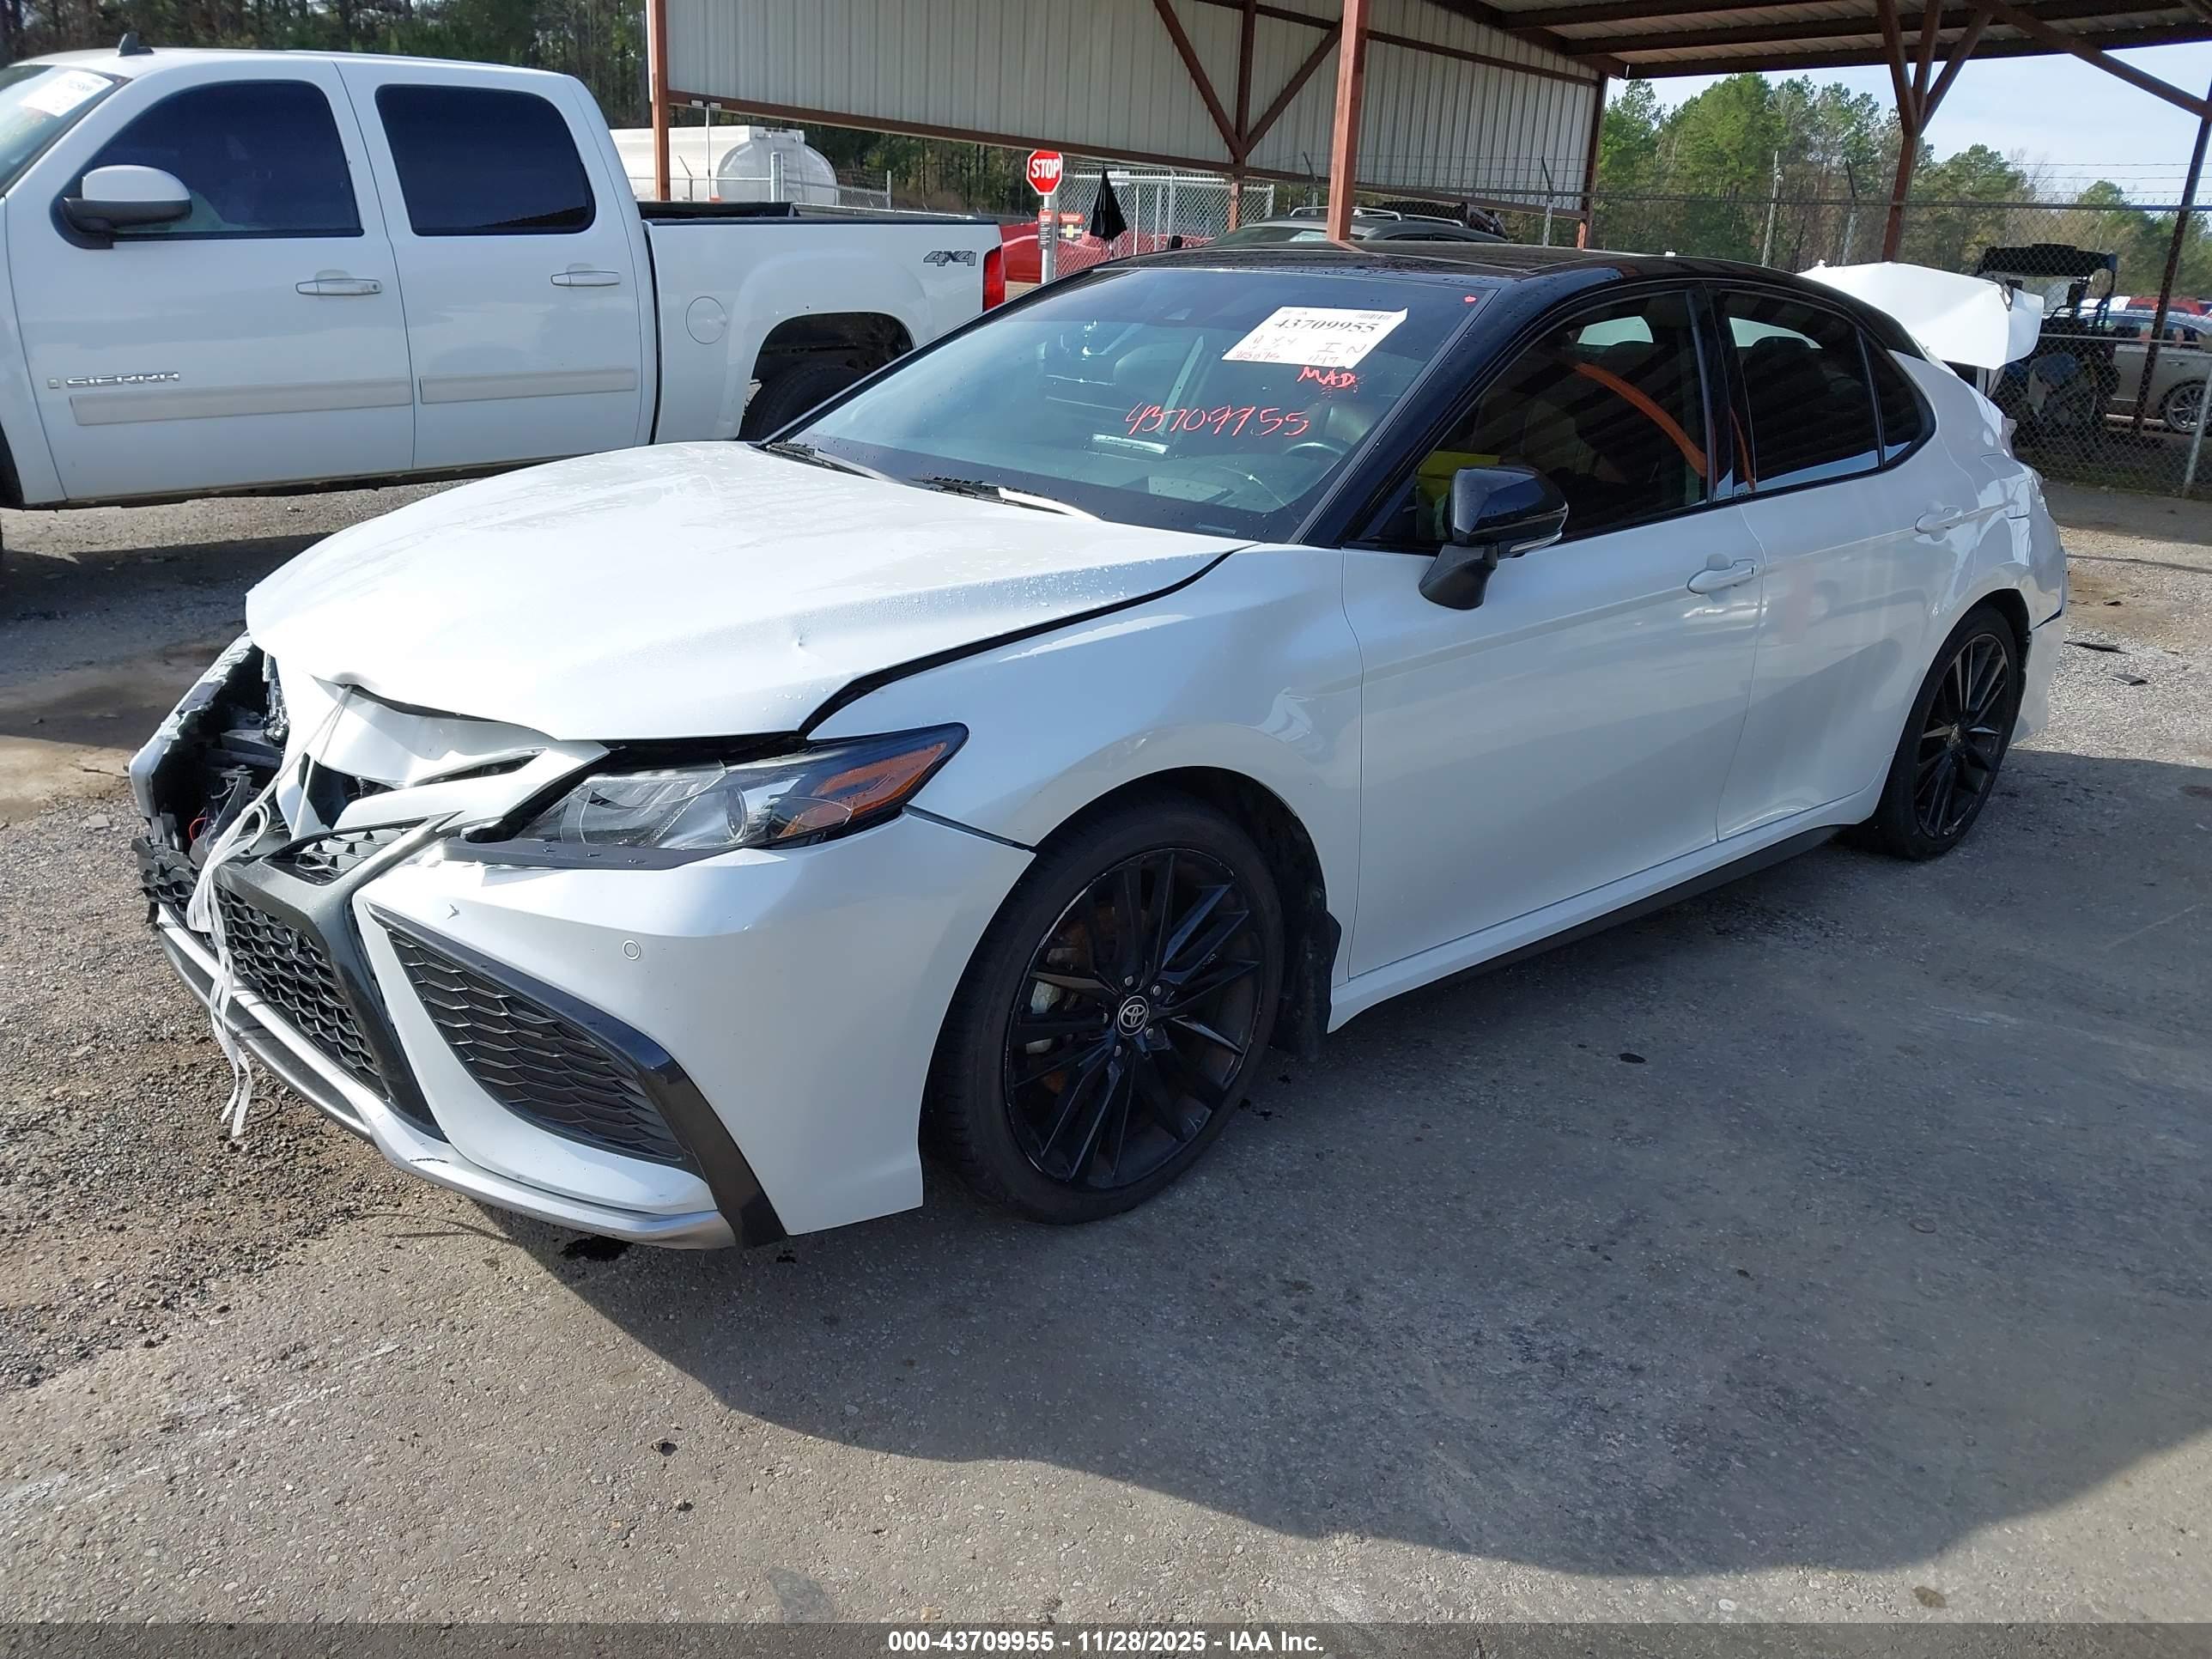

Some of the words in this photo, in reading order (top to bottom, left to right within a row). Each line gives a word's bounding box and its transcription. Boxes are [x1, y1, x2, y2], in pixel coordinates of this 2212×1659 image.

[1030, 158, 1060, 179] STOP
[1274, 319, 1380, 333] 43709955
[65, 371, 180, 387] SIERRA
